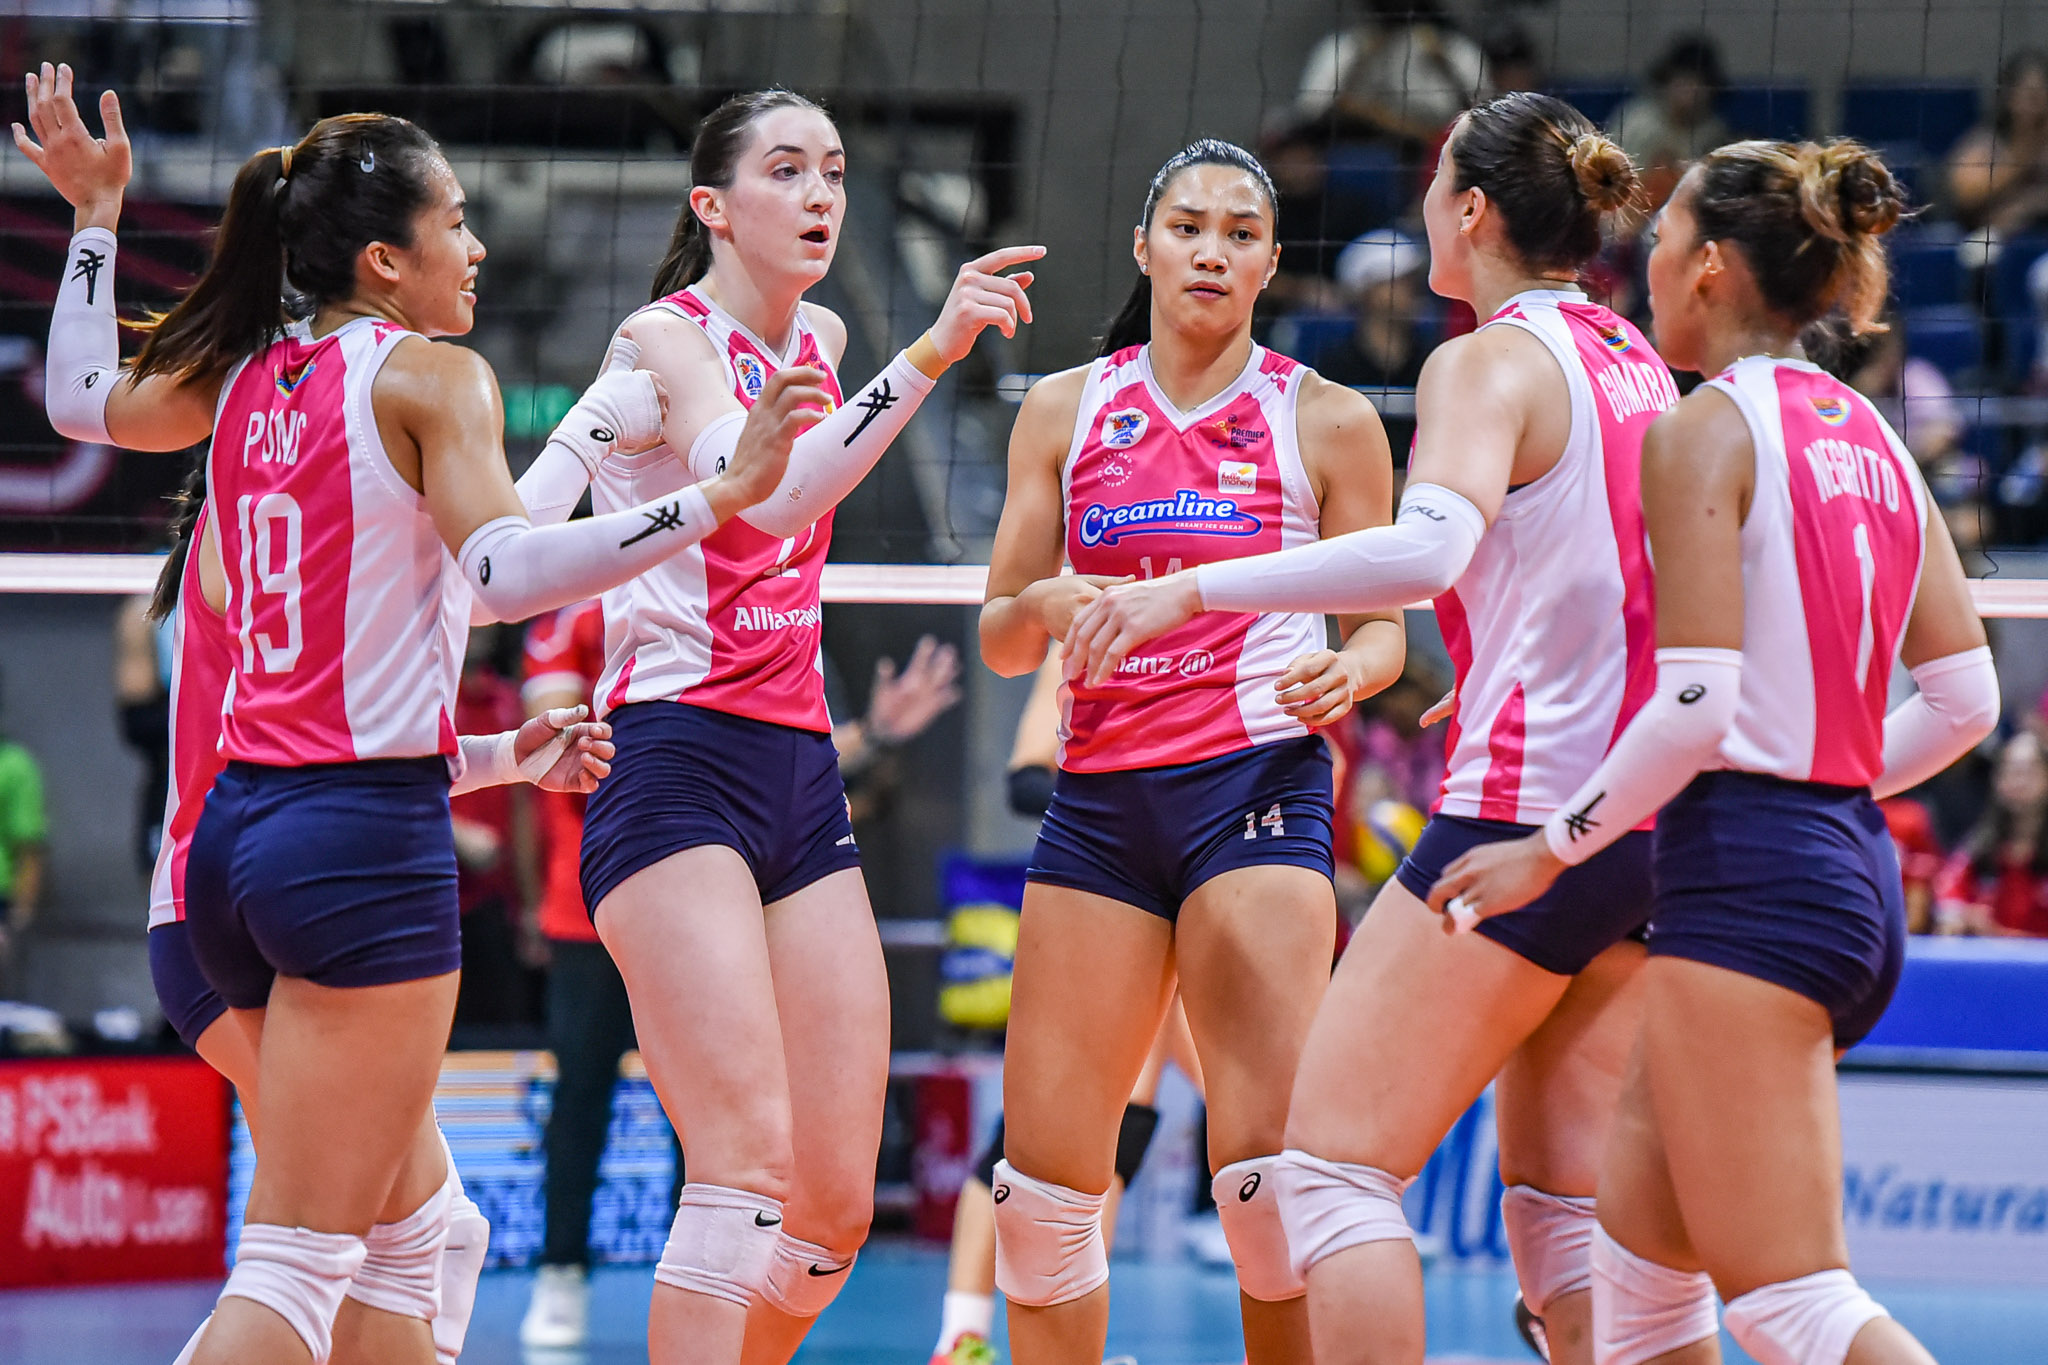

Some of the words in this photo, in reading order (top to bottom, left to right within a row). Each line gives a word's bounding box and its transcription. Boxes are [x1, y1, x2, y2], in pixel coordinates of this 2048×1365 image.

[243, 408, 307, 468] PONS
[1231, 427, 1265, 438] PREMIER
[1221, 479, 1252, 489] money
[1803, 438, 1900, 513] NEGRITO
[1082, 493, 1234, 545] Creamline
[237, 493, 303, 674] 19
[1852, 523, 1875, 694] 1
[1244, 803, 1285, 840] 14
